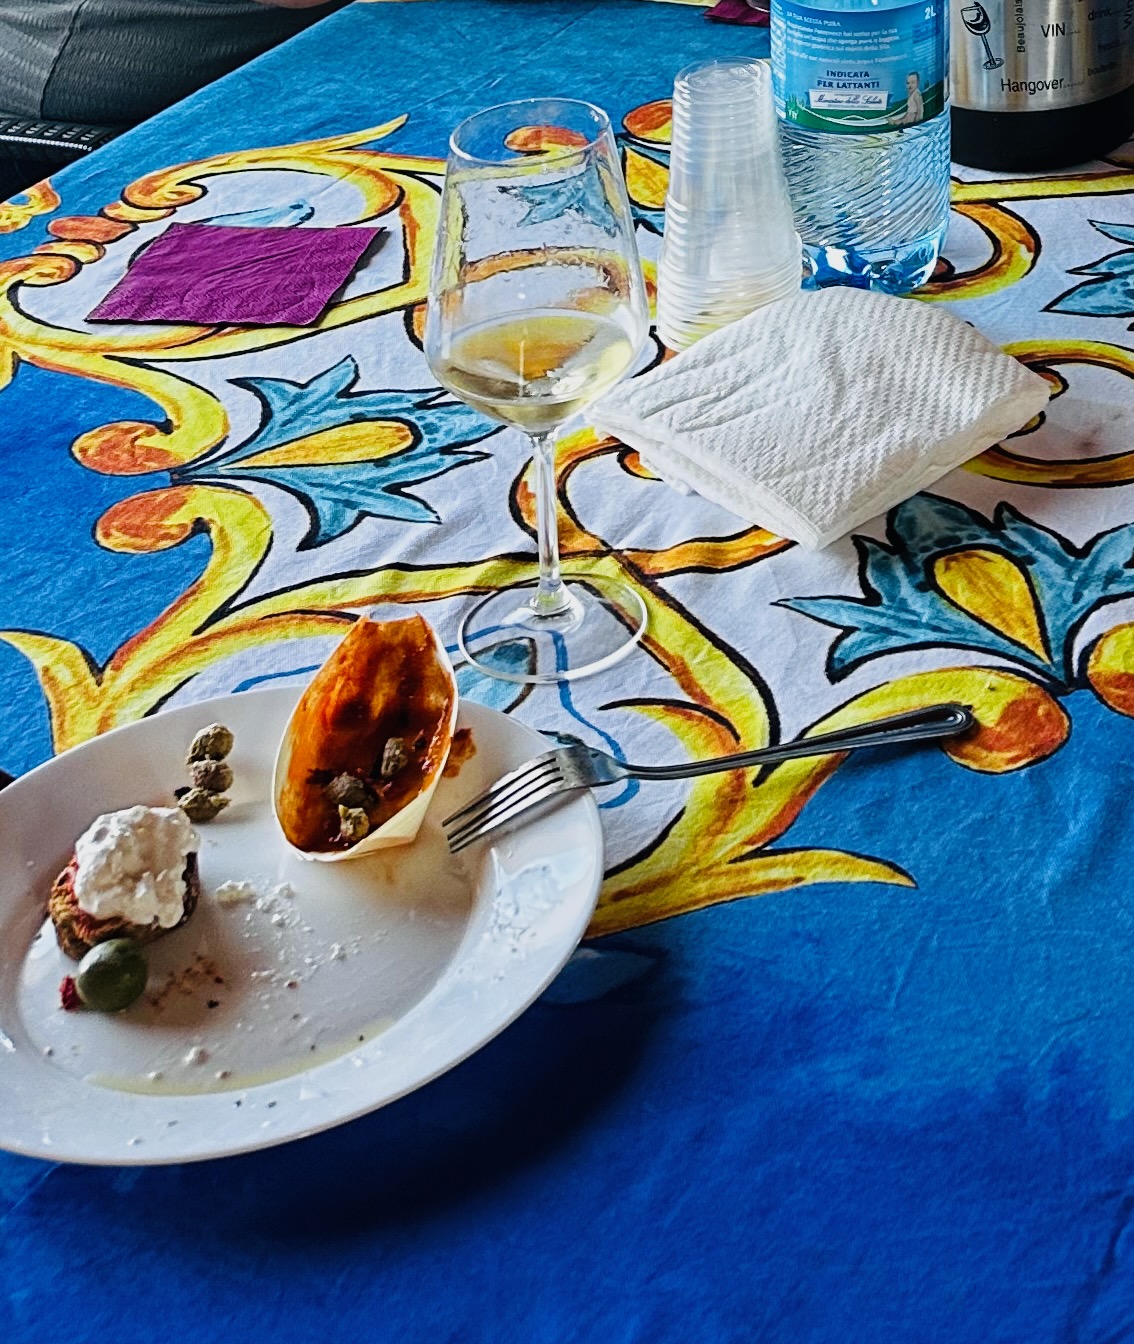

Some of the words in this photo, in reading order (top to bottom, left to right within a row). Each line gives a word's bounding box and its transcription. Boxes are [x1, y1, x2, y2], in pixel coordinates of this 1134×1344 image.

[924, 6, 936, 20] 2L
[826, 69, 870, 78] INDICATA
[817, 80, 833, 88] PER
[836, 81, 880, 89] LATTANTI
